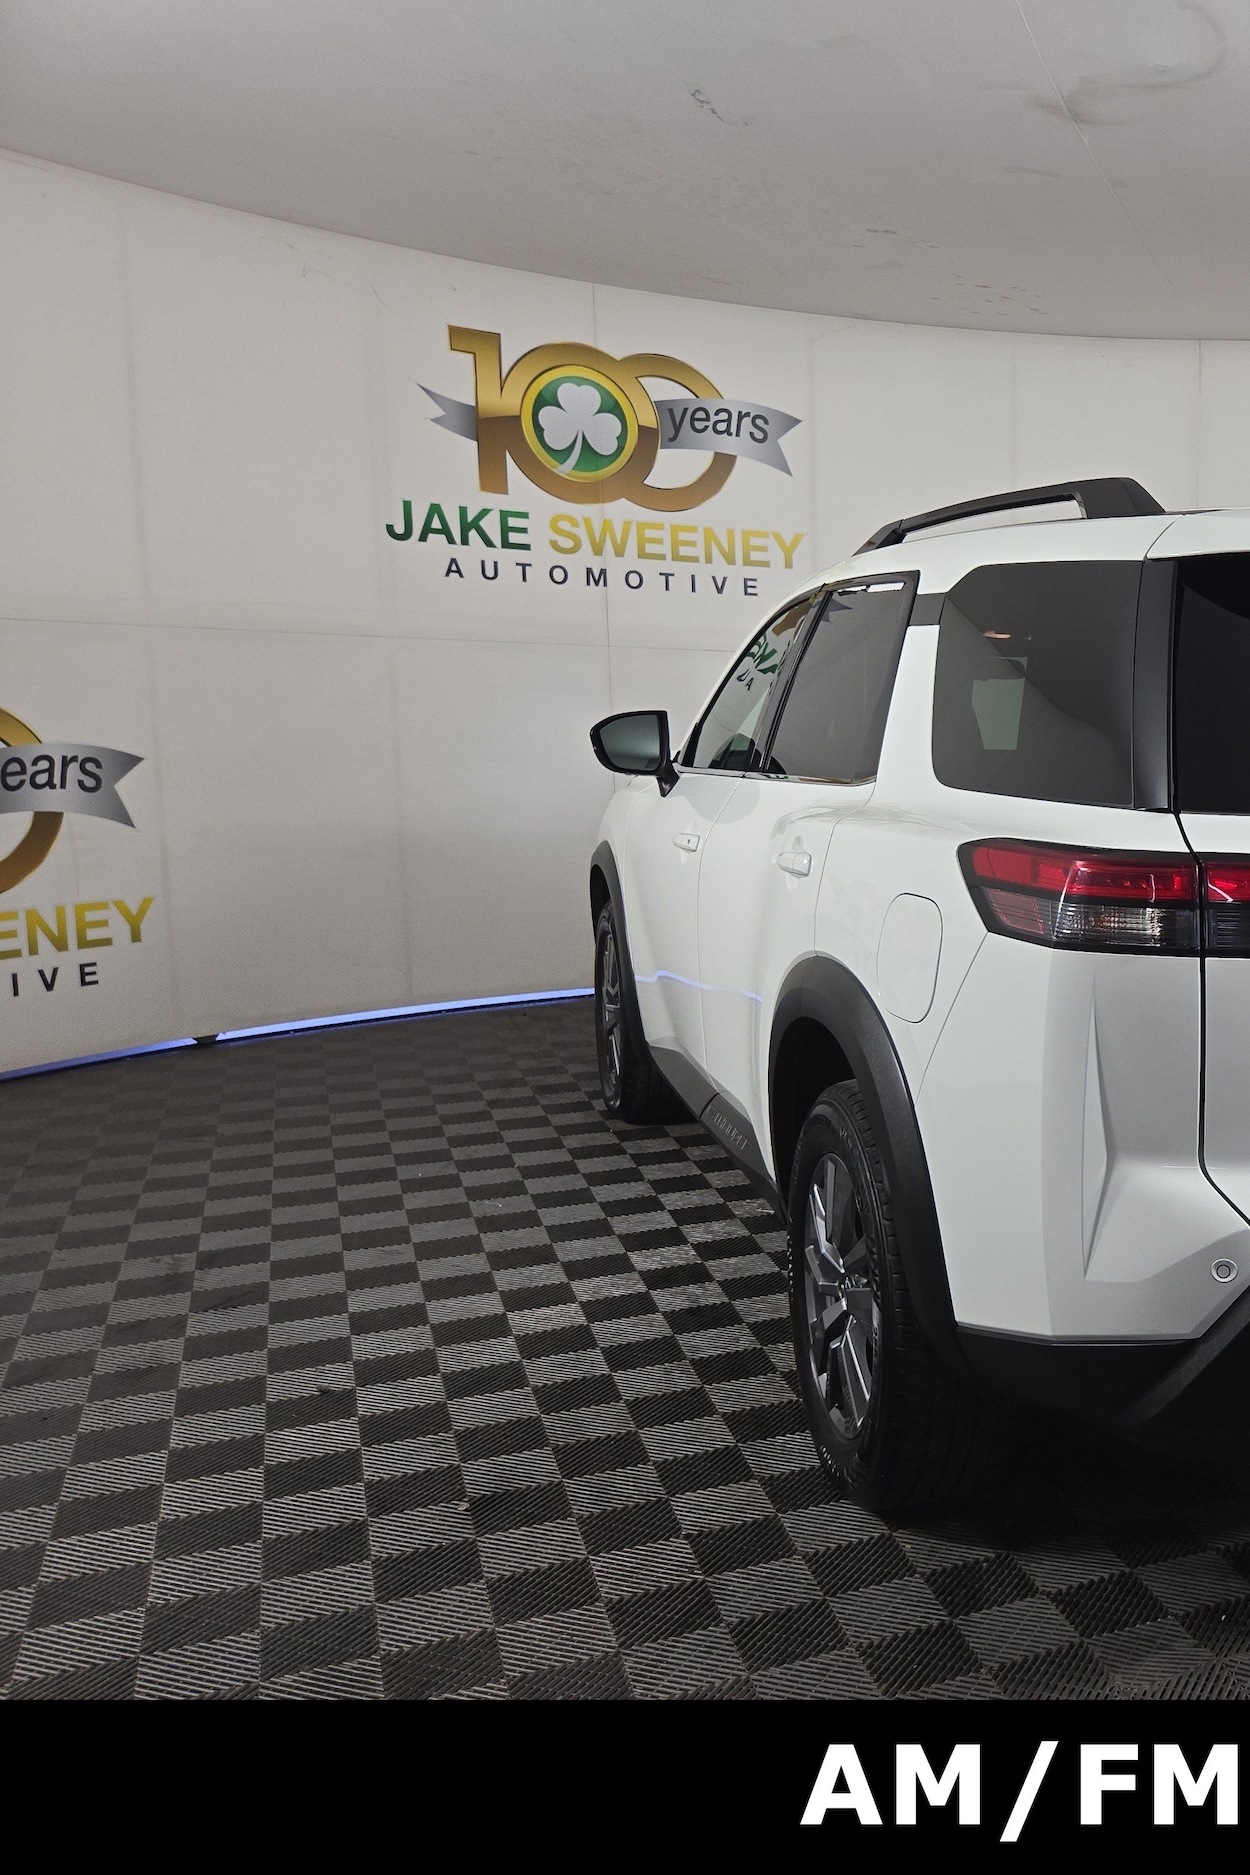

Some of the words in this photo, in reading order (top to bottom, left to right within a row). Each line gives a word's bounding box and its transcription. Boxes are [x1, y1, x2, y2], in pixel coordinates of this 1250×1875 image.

[448, 324, 738, 512] 100
[667, 406, 770, 444] years
[386, 500, 532, 551] JAKE
[549, 514, 804, 569] SWEENEY
[445, 558, 759, 597] AUTOMOTIVE
[1, 754, 103, 793] ears
[0, 897, 155, 960] ENEY
[11, 962, 99, 997] IVE
